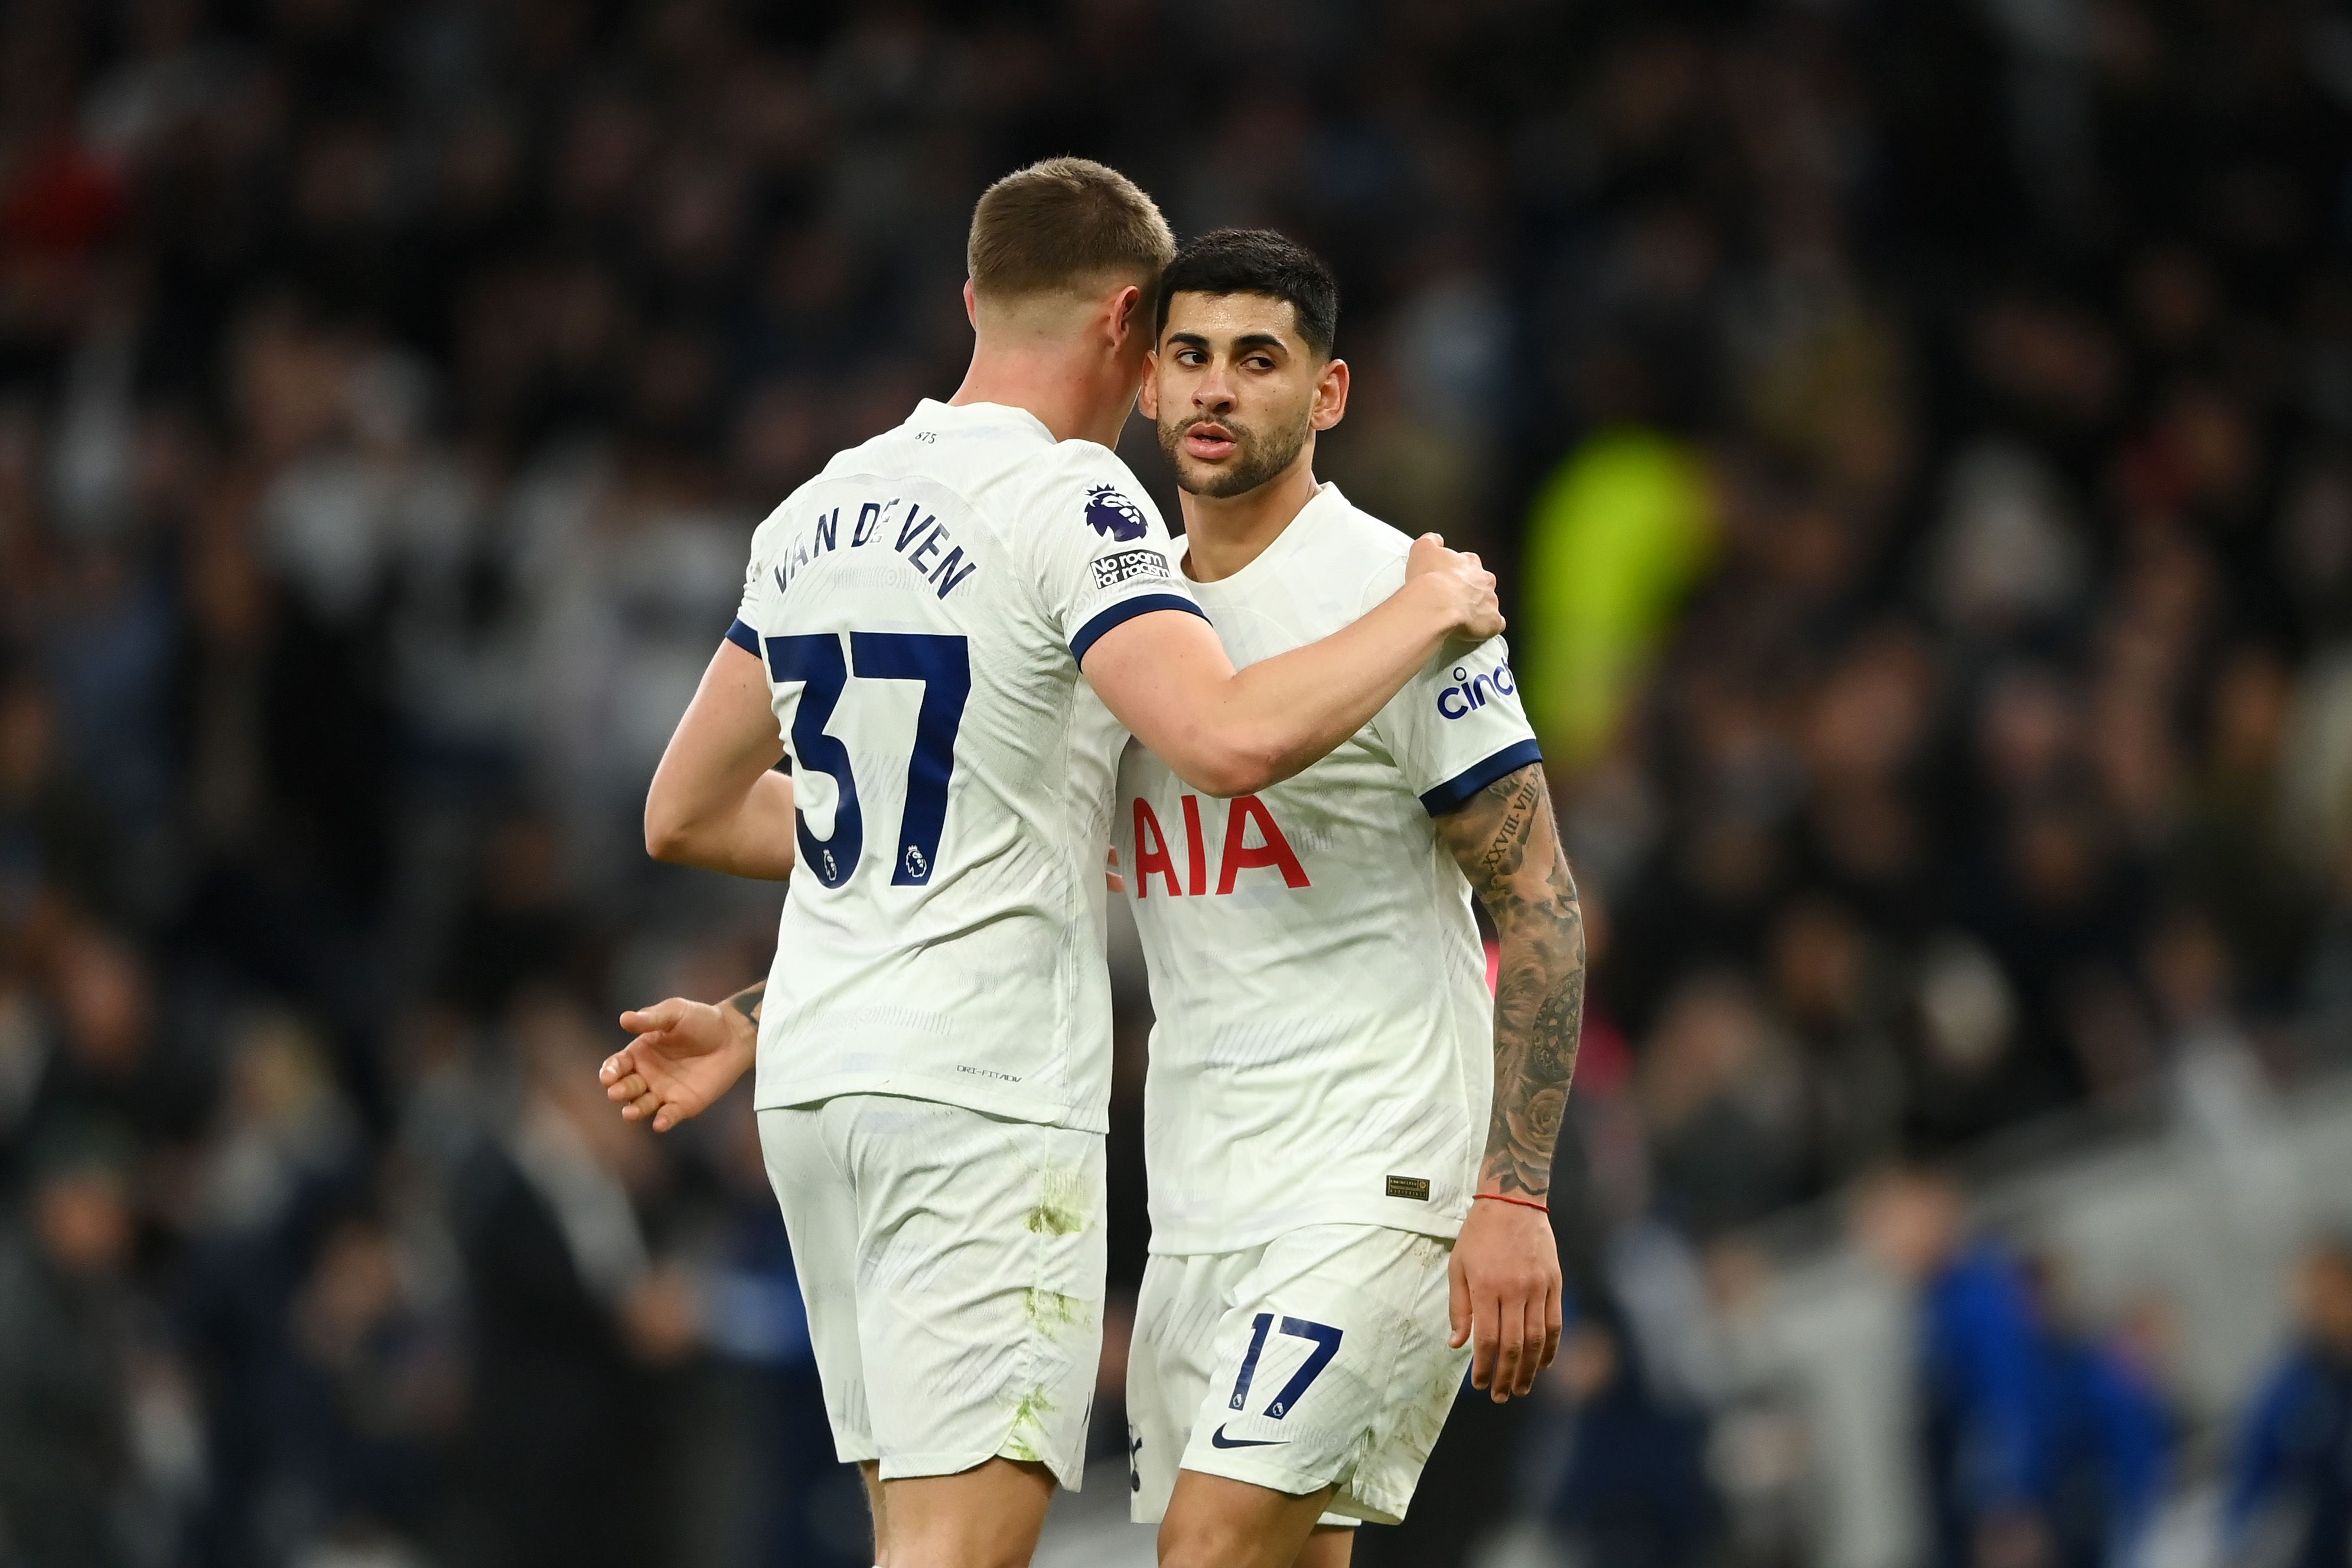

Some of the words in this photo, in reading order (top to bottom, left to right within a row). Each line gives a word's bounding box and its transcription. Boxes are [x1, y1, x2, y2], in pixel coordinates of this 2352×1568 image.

[915, 432, 937, 444] 875
[774, 507, 840, 595] VAN
[851, 498, 901, 548] DE
[894, 503, 978, 601] VEN
[1091, 558, 1118, 577] No
[1119, 552, 1163, 568] room
[1095, 570, 1119, 589] for
[1122, 563, 1170, 579] racism
[764, 631, 972, 890] 37
[1133, 795, 1312, 898] AIA
[1228, 1313, 1344, 1420] 17
